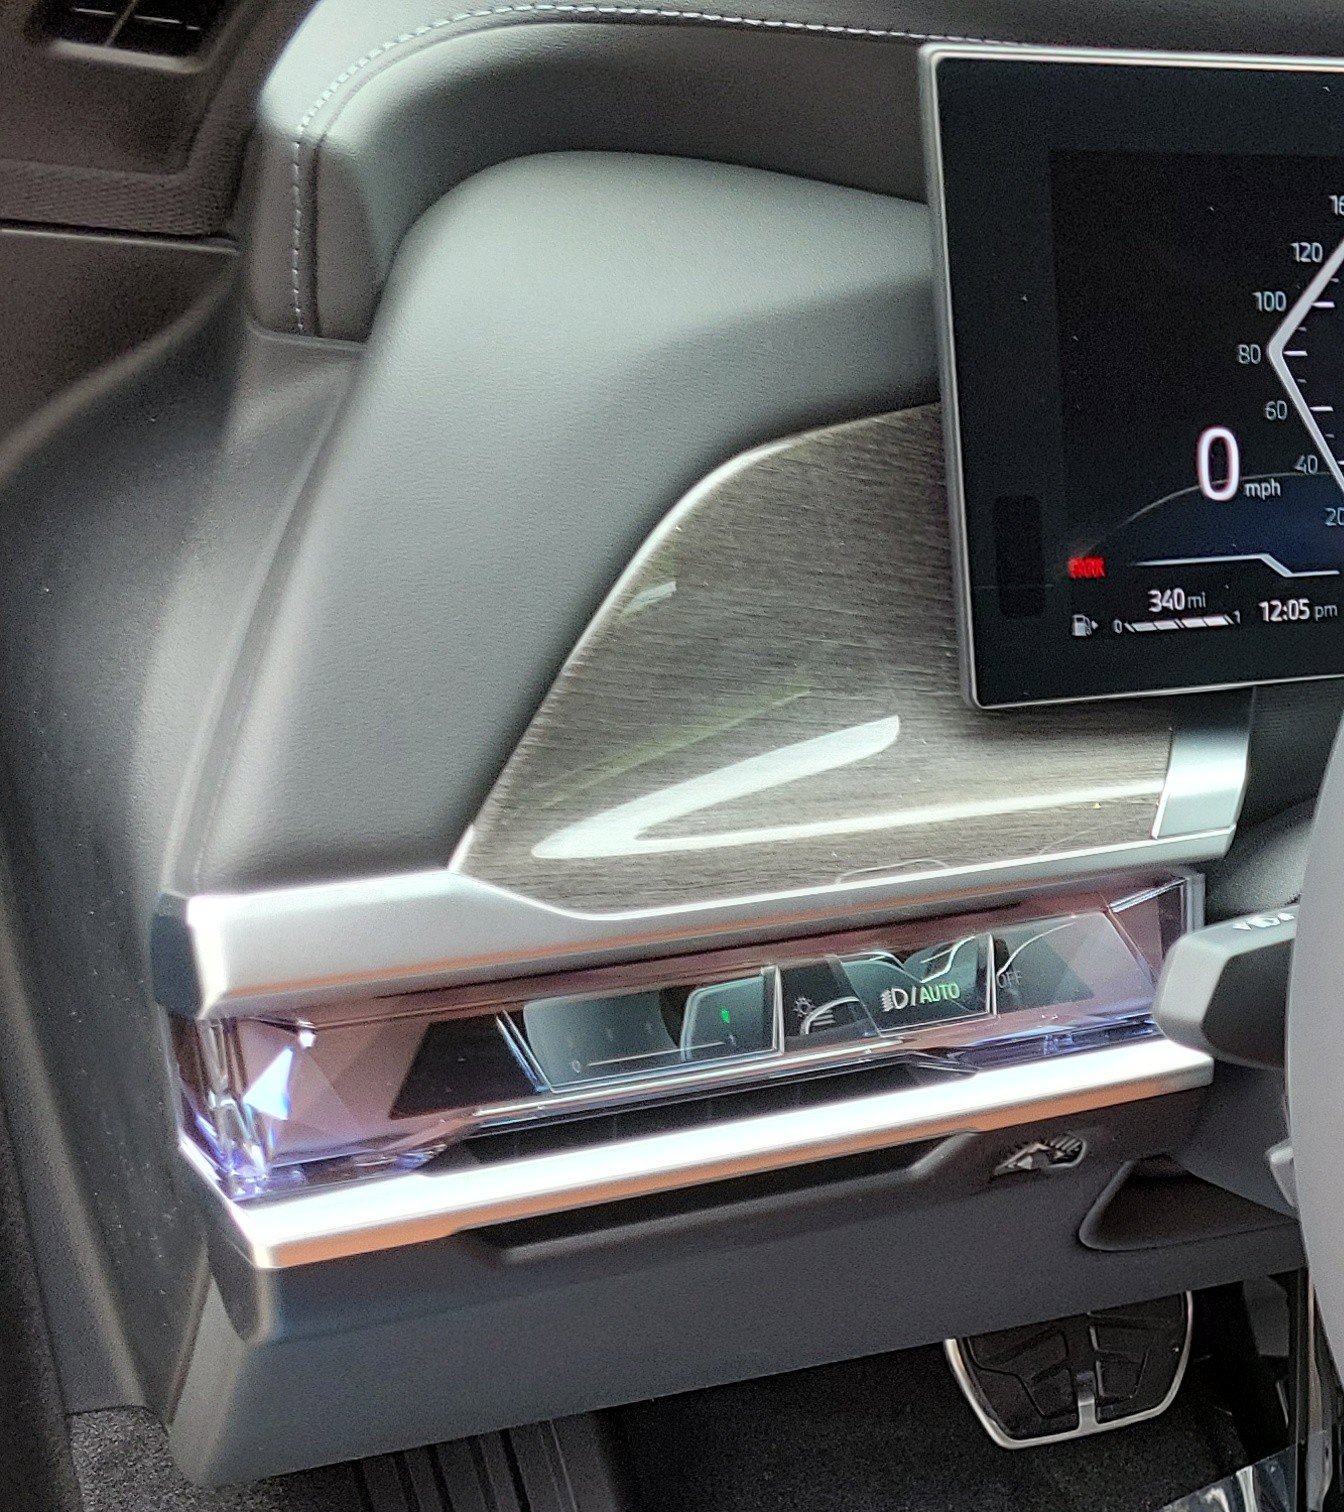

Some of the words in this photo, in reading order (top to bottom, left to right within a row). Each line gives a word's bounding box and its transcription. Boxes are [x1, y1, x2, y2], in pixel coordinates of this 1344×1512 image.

[1292, 242, 1323, 263] 120
[1254, 291, 1286, 312] 100
[1238, 344, 1261, 364] 80
[1265, 401, 1288, 420] 60
[1198, 426, 1240, 501] 0
[1244, 479, 1281, 500] mph
[1295, 454, 1318, 474] 40
[1148, 587, 1186, 612] 340
[1187, 591, 1206, 609] mi
[1259, 599, 1311, 622] 12:05
[1314, 602, 1338, 620] pm
[1113, 619, 1123, 635] 0
[919, 982, 960, 1005] AUTO
